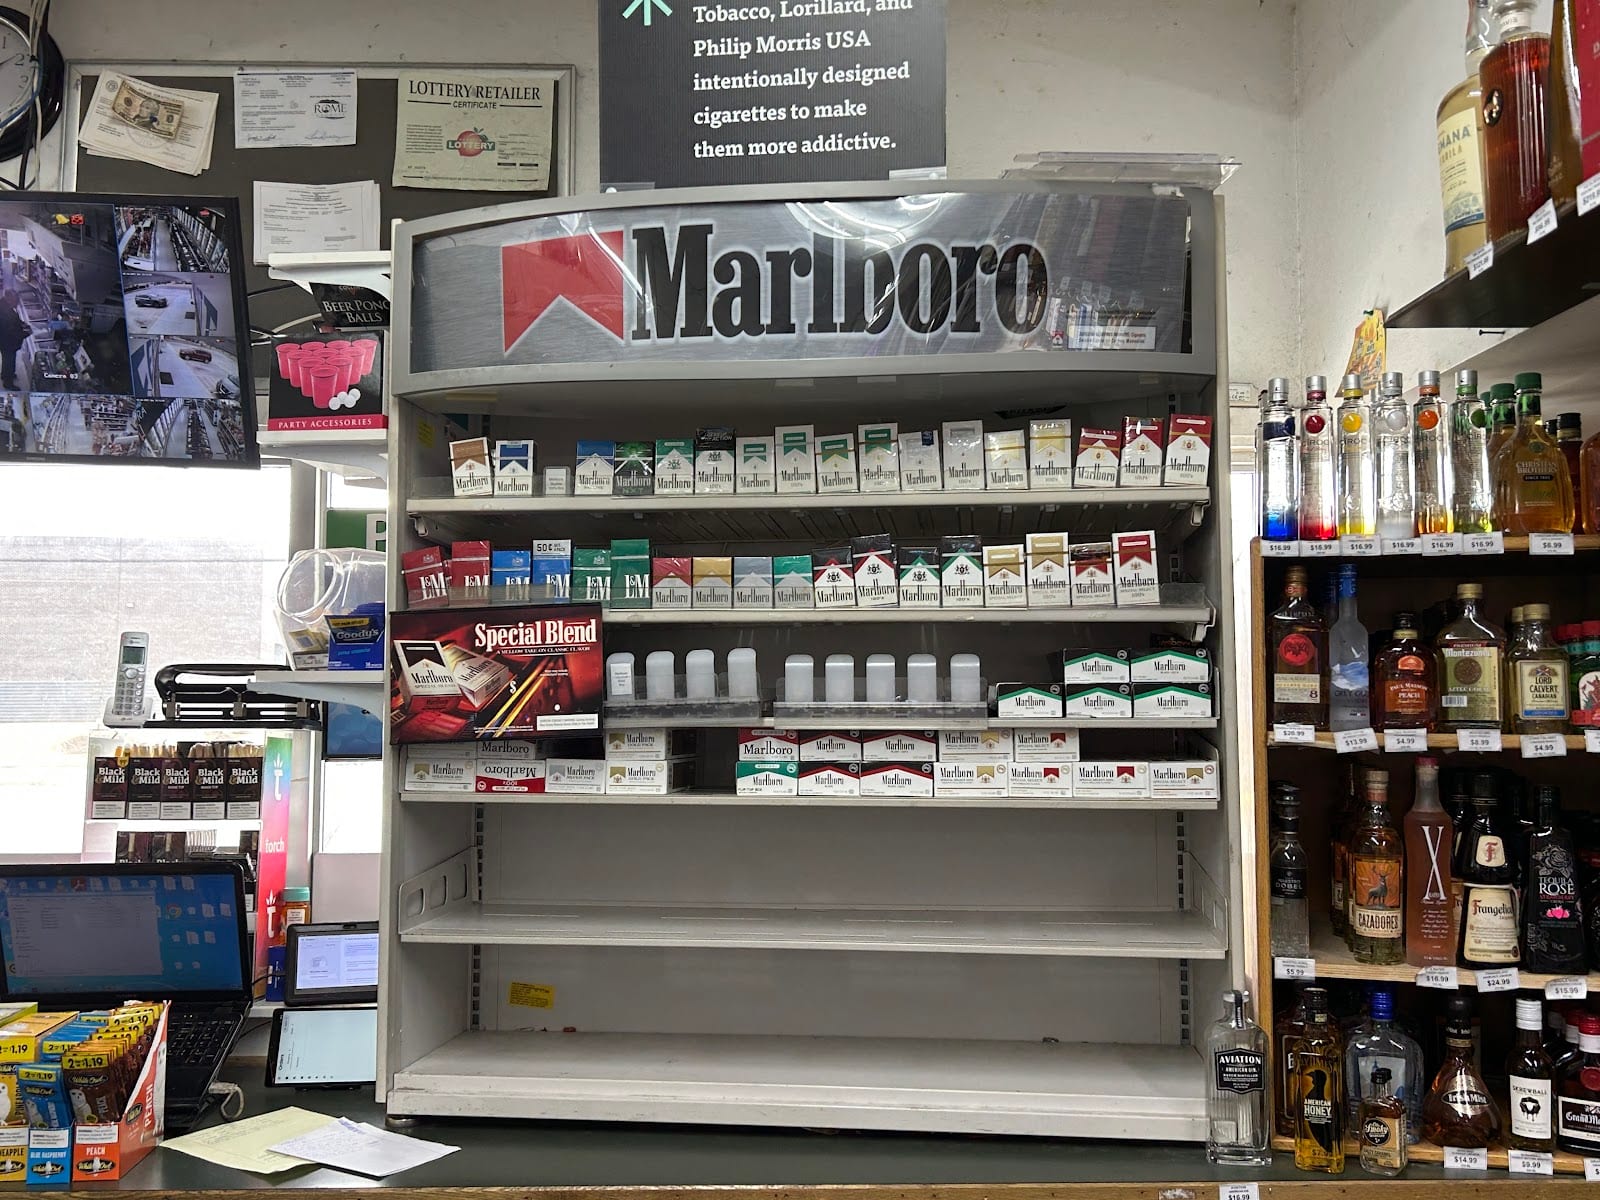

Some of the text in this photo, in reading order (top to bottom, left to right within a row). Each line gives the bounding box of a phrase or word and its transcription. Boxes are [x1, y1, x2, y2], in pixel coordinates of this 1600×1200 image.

[693, 4, 775, 23] Tobacco,
[780, 0, 871, 17] Lorillard,
[693, 30, 871, 59] Philip Morris USA
[693, 61, 910, 91] intentionally designed
[409, 80, 541, 100] LOTTERY RETAILER
[452, 101, 497, 109] CERTIFICATE
[693, 99, 867, 128] cigarettes to make
[448, 140, 496, 150] LOTTERY
[693, 132, 897, 158] them more addictive.
[631, 222, 1048, 341] Marlboro
[322, 300, 355, 312] BEER
[345, 312, 382, 323] BALLS
[279, 418, 372, 429] PARTY ACCESSORIES
[698, 466, 733, 483] Marlboro
[781, 466, 812, 481] Marlboro
[906, 468, 937, 486] Marlboro
[948, 462, 980, 478] Marlboro
[991, 468, 1024, 483] Marlboro
[1078, 463, 1116, 481] Marlboro
[456, 473, 489, 489] Marlboro
[497, 477, 529, 492] Marlboro
[616, 470, 650, 486] Marlboro
[657, 473, 691, 489] Marlboro
[821, 471, 853, 486] Marlboro
[419, 571, 448, 601] L&M
[464, 574, 490, 599] L&M
[545, 573, 570, 599] L&M
[585, 575, 611, 601] L&M
[624, 573, 650, 599] L&M
[858, 578, 896, 597] Marlboro
[944, 579, 982, 596] Marlboro
[988, 580, 1023, 595] Marlboro
[1031, 574, 1066, 589] Marlboro
[1075, 579, 1111, 594] Marlboro
[1119, 573, 1155, 588] Marlboro
[505, 576, 530, 601] L&M
[655, 588, 688, 603] Marlboro
[695, 588, 729, 603] Marlboro
[736, 588, 770, 603] Marlboro
[777, 587, 811, 602] Marlboro
[816, 585, 853, 602] Marlboro
[901, 587, 938, 602] Marlboro
[336, 629, 379, 640] Goody's
[475, 618, 598, 652] Special Blend
[1081, 658, 1113, 672] Marlboro
[1154, 657, 1186, 671] Marlboro
[411, 669, 454, 684] Marlboro
[1535, 677, 1552, 685] LORD
[1309, 690, 1318, 698] 8
[1529, 685, 1559, 694] CALVERT
[1015, 692, 1046, 706] Marlboro
[1083, 692, 1115, 707] Marlboro
[1157, 692, 1189, 707] Marlboro
[626, 732, 655, 745] Marlboro
[816, 738, 846, 751] Marlboro
[885, 738, 915, 751] Marlboro
[945, 731, 979, 744] Marlboro
[1017, 732, 1049, 744] Marlboro
[743, 740, 793, 756] Marlboro
[99, 767, 125, 776] Black
[134, 768, 161, 776] Black
[165, 768, 190, 777] Black
[198, 768, 224, 777] Black
[232, 768, 258, 776] Black
[432, 763, 464, 776] Marlboro
[484, 767, 537, 778] Marlboro
[567, 765, 596, 776] Marlboro
[627, 765, 656, 777] Marlboro
[940, 766, 974, 778] Marlboro
[1011, 767, 1043, 779] Marlboro
[1079, 765, 1114, 778] Marlboro
[1153, 767, 1186, 780] Marlboro
[752, 772, 784, 787] Marlboro
[814, 772, 845, 786] Marlboro
[882, 772, 912, 787] Marlboro
[1275, 882, 1303, 890] DOBEL
[1538, 876, 1573, 884] TEQUILA
[1539, 883, 1575, 896] ROSE
[1358, 912, 1398, 930] CAZADORES
[1487, 978, 1511, 987] $24.99
[1219, 1056, 1261, 1064] AVIATION
[1512, 1085, 1547, 1095] SKREWBALL
[145, 1084, 154, 1127] PEACH
[1304, 1099, 1331, 1107] AMERICAN
[1304, 1105, 1332, 1116] HONEY
[86, 1147, 105, 1155] PEACH
